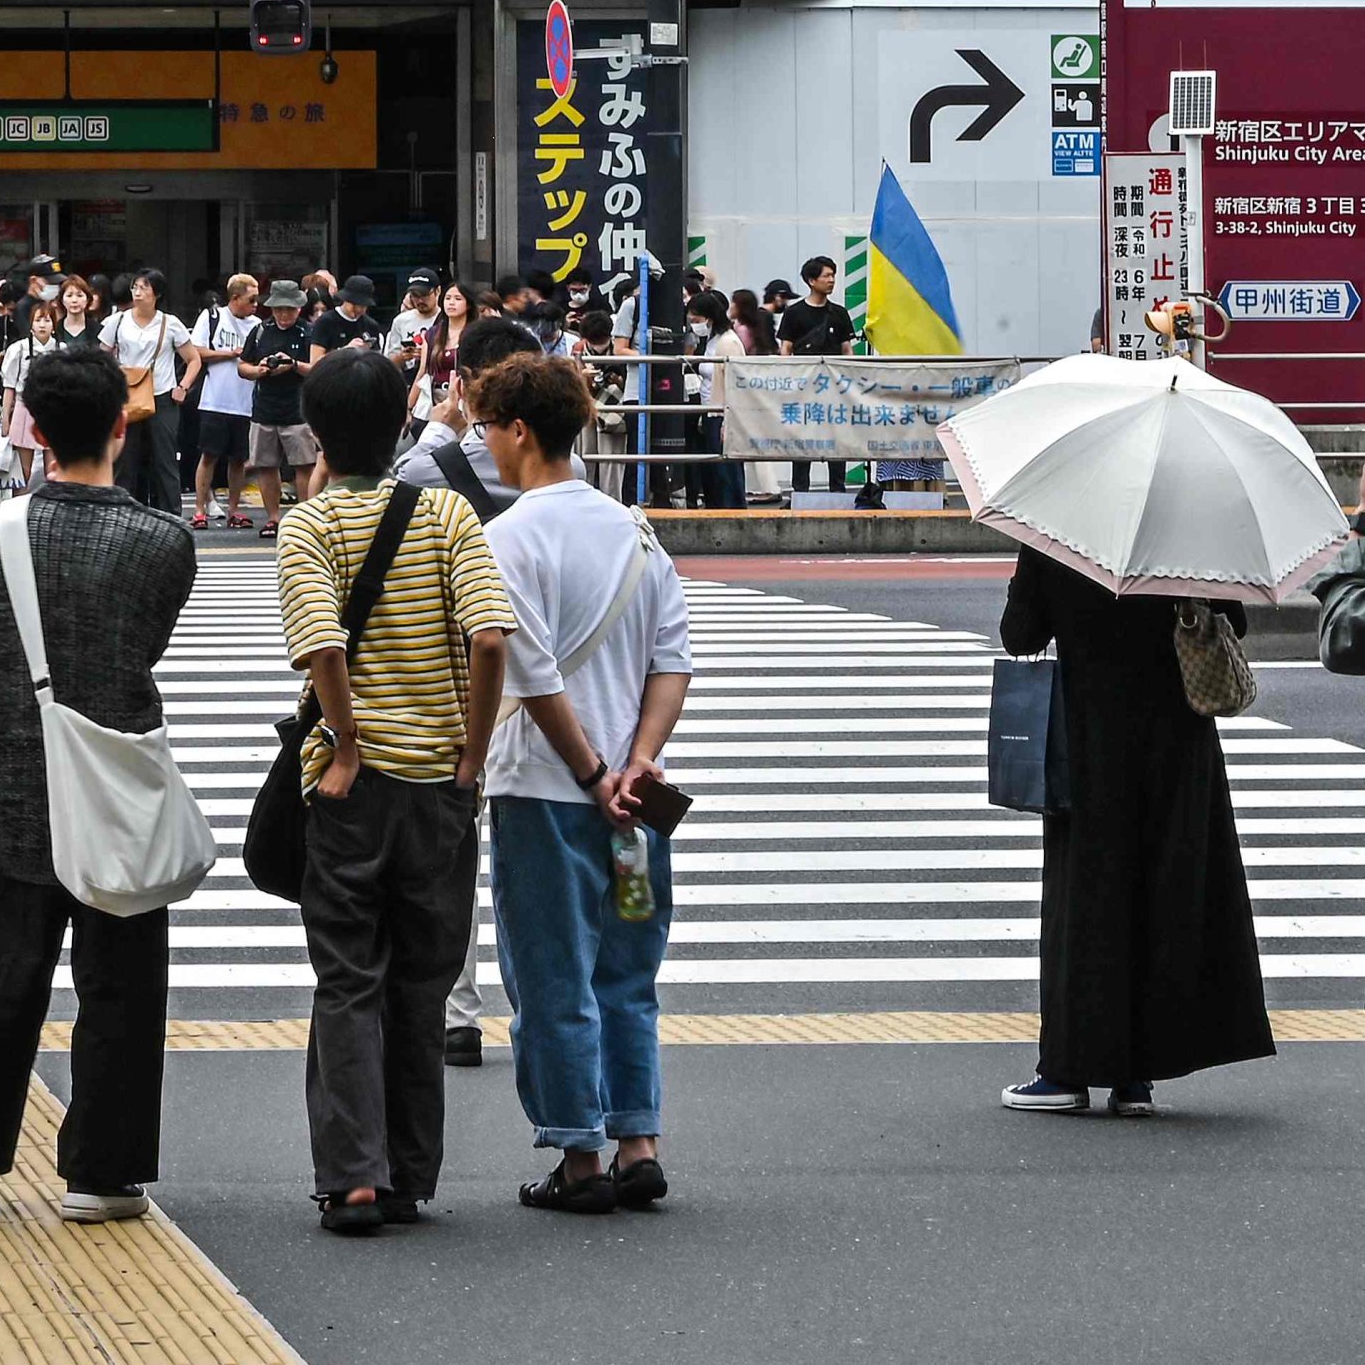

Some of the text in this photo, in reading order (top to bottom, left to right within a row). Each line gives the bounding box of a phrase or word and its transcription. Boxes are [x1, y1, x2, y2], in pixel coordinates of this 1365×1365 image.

[11, 123, 24, 134] JC
[37, 123, 50, 134] JB
[63, 123, 77, 134] JA
[90, 123, 103, 134] JS
[1055, 134, 1094, 149] ATM
[1215, 145, 1289, 164] Shinjuku
[1294, 146, 1327, 165] City
[534, 78, 588, 283] ステップ
[1113, 186, 1127, 217] 時間
[1131, 185, 1144, 217] 期間
[1216, 220, 1356, 236] 3-38-2, Shinjuku City
[1114, 226, 1128, 258] 深夜
[1132, 229, 1145, 256] 令和
[1235, 288, 1341, 314] 甲州街道
